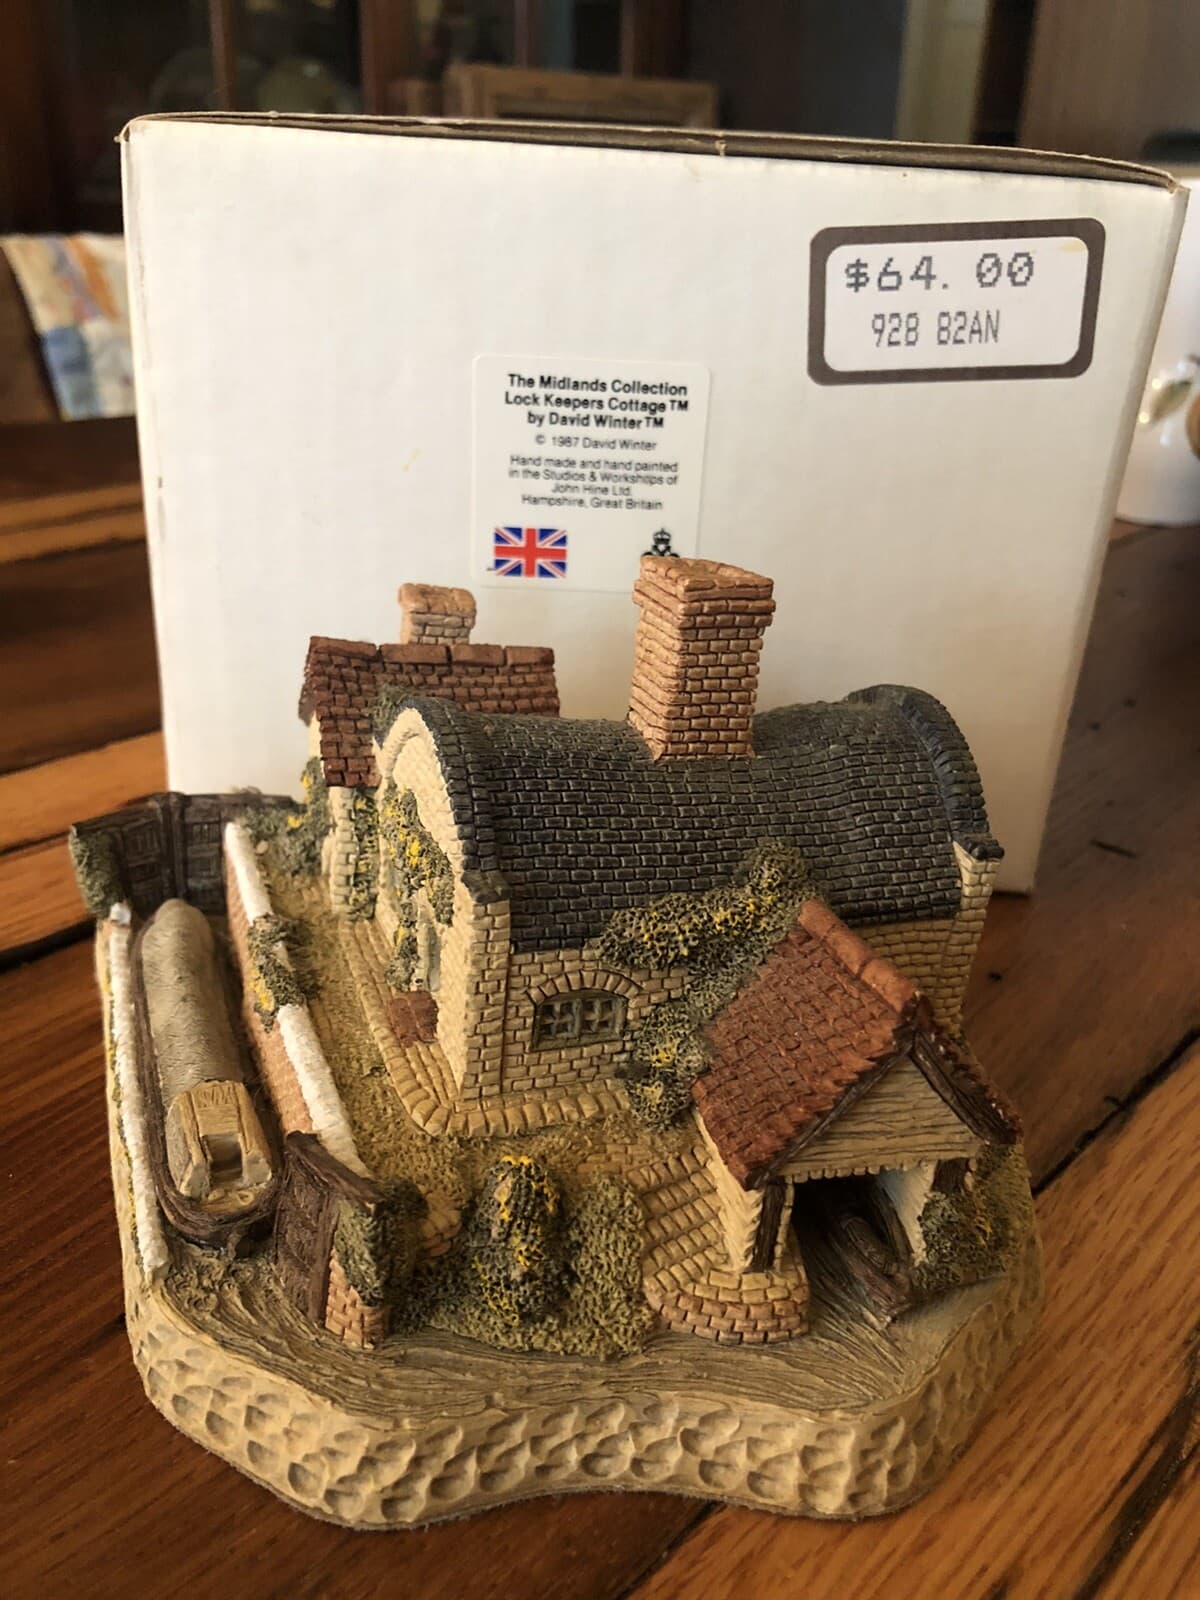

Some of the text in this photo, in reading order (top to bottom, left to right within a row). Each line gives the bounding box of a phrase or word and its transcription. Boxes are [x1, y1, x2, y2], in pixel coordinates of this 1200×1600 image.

[508, 374, 688, 396] The Midlands Collection
[505, 391, 540, 406] Lock
[544, 394, 604, 411] Keepers
[527, 411, 545, 427] by
[549, 412, 591, 427] David
[552, 436, 580, 448] 1987
[583, 437, 617, 450] David
[619, 439, 657, 451] Winter
[510, 455, 678, 473] Hand made and hand painted
[509, 468, 519, 479] in
[522, 469, 541, 480] the
[543, 469, 586, 482] Studios
[600, 473, 664, 486] Workshops
[667, 475, 678, 485] of
[551, 484, 580, 494] John
[583, 485, 609, 496] Hine
[590, 496, 623, 510] Great
[625, 498, 663, 511] Britain
